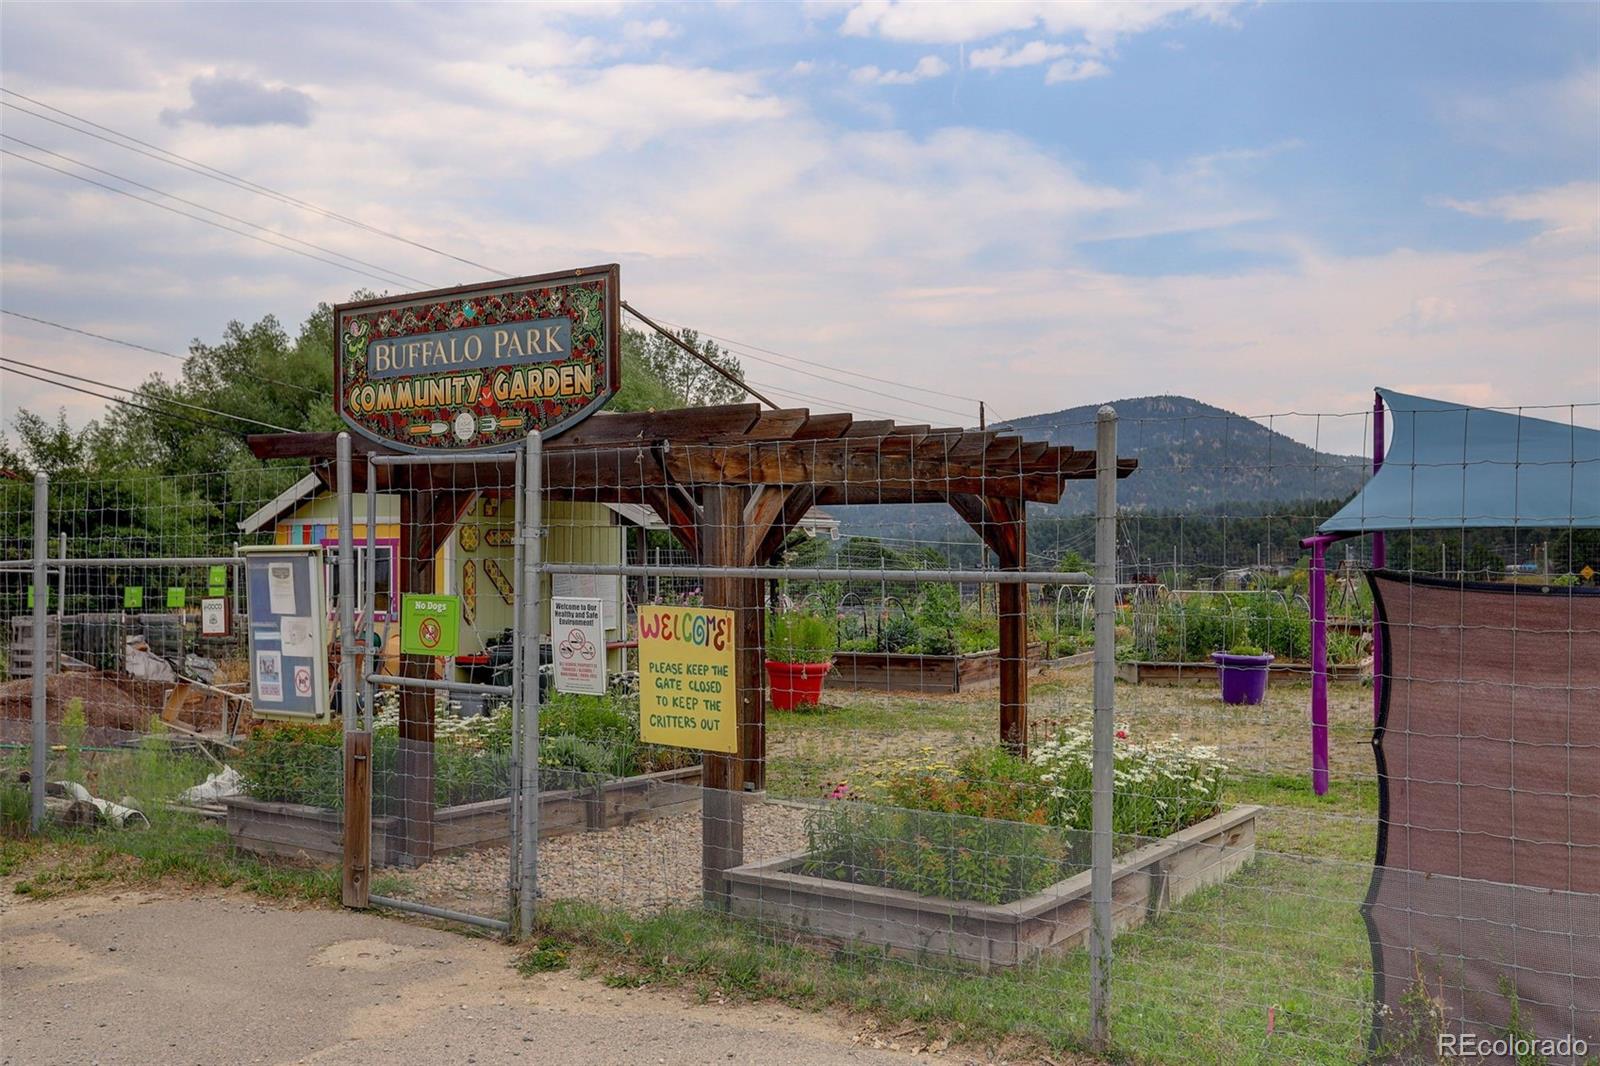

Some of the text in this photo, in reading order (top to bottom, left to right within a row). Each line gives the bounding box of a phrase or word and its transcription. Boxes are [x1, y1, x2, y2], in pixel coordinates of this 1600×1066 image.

[375, 325, 565, 372] BUFFALO PARK
[350, 362, 593, 413] COMMUNITY GARDEN
[415, 601, 447, 612] No Dogs
[555, 602, 580, 611] Welcome
[555, 610, 599, 619] Healthy and Safe
[640, 612, 732, 652] WELCOME!
[649, 662, 729, 677] PLEASE KEEP THE
[655, 677, 722, 694] GATE CLOSED
[656, 695, 722, 712] TO KEEP THE
[649, 713, 721, 731] CRITTERS OUT
